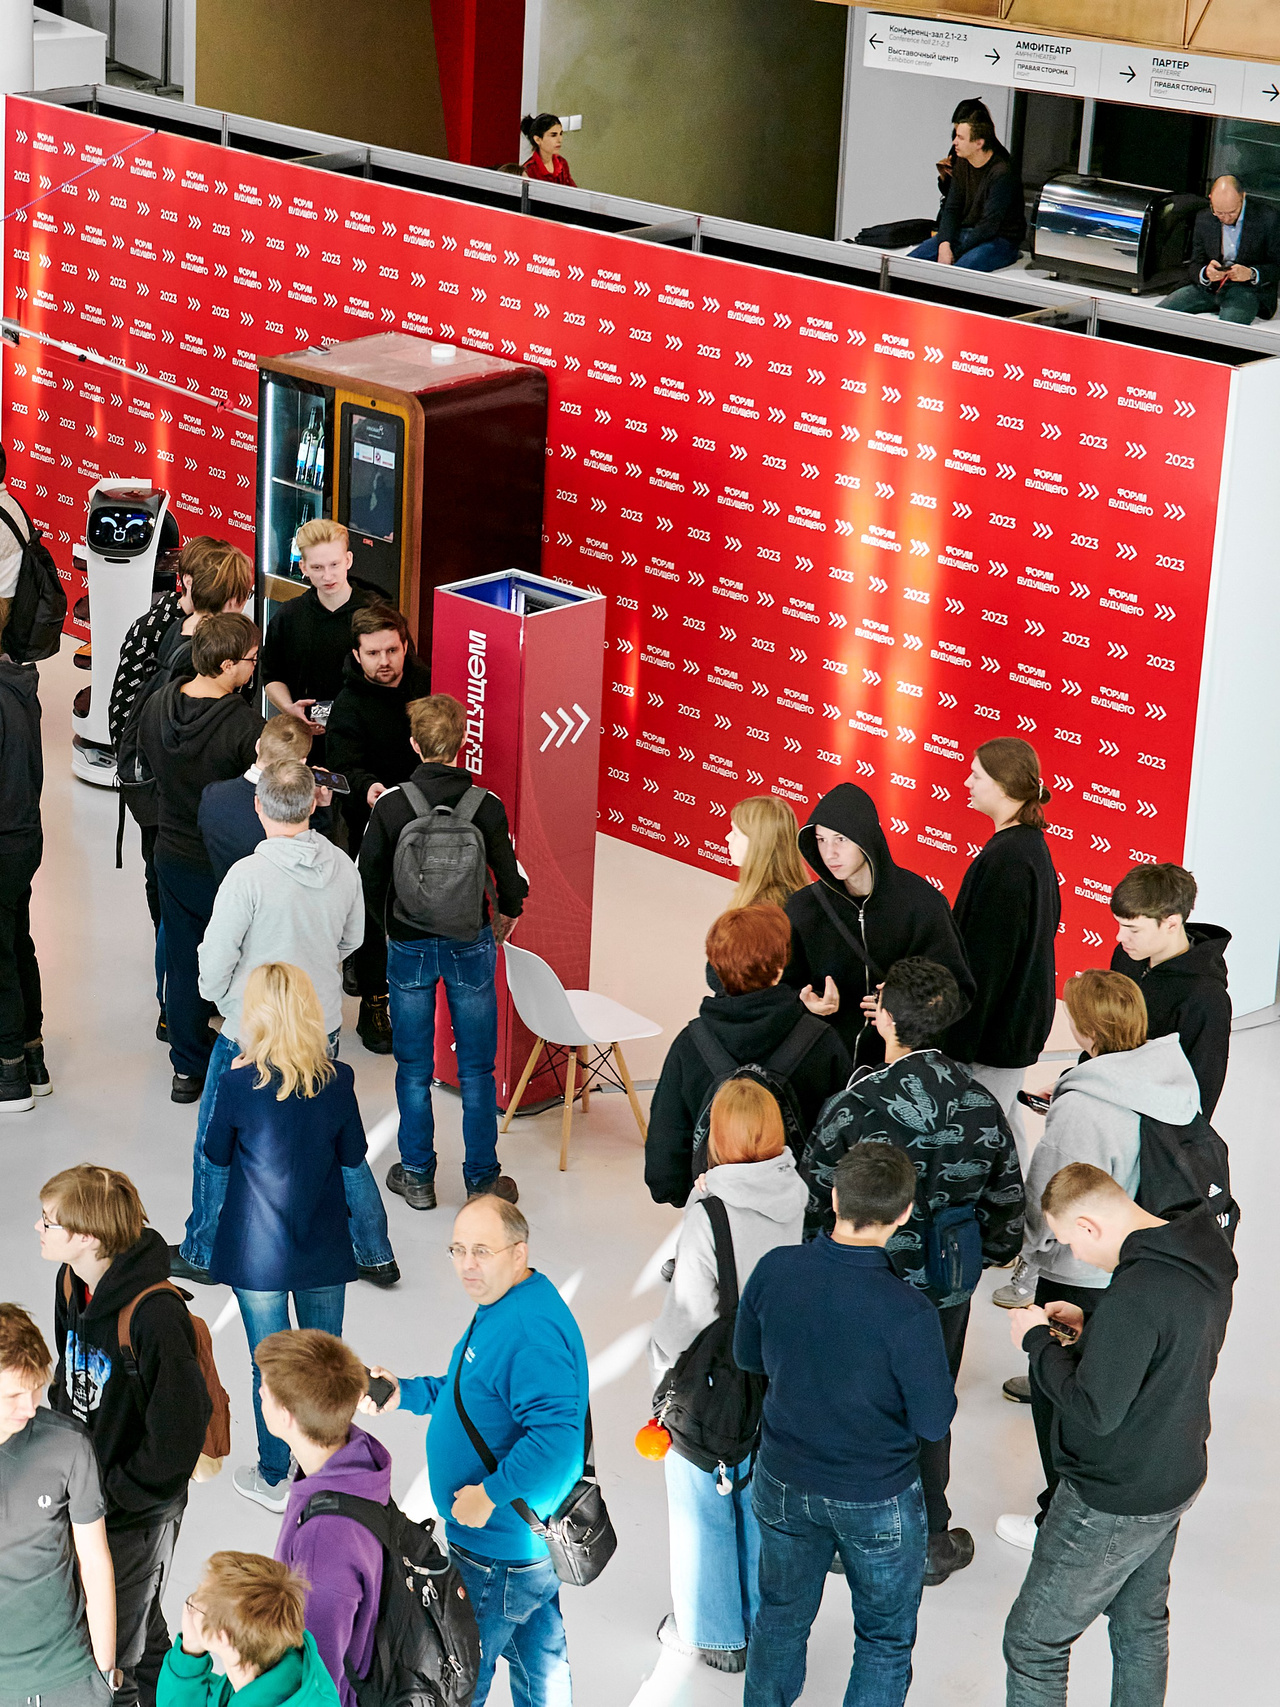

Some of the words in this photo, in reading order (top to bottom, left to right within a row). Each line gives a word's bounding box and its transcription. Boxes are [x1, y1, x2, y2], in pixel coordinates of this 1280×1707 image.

[889, 25, 944, 39] Конференц-зал
[944, 32, 968, 42] 2.1-2.3
[889, 33, 920, 44] Conference
[888, 46, 937, 59] Выставочный
[937, 54, 960, 63] центр
[1016, 41, 1072, 55] АМФИТЕАТР
[888, 55, 915, 64] Exhibition
[915, 59, 933, 67] center
[1152, 57, 1190, 70] ПАРТЕР
[1017, 63, 1041, 72] ПРАВАЯ
[1041, 66, 1069, 75] СТОРОНА
[1151, 67, 1182, 77] PARTERRE
[1154, 80, 1181, 90] ПРАВАЯ
[1181, 84, 1213, 94] СТОРОНА
[14, 170, 30, 183] 2023
[110, 196, 127, 209] 2023
[213, 223, 230, 236] 2023
[266, 237, 284, 250] 2023
[61, 262, 77, 275] 2023
[379, 265, 399, 279] 2023
[598, 269, 621, 282] ФОРУМ
[438, 280, 459, 295] 2023
[160, 290, 177, 303] 2023
[500, 296, 521, 310] 2023
[735, 301, 759, 313] ФОРУМ
[563, 312, 585, 326] 2023
[265, 320, 283, 334] 2023
[629, 328, 651, 342] 2023
[882, 334, 909, 347] ФОРУМ
[697, 344, 720, 359] 2023
[960, 351, 988, 364] ФОРУМ
[768, 361, 792, 376] 2023
[1042, 368, 1070, 382] ФОРУМ
[841, 378, 867, 394] 2023
[1127, 386, 1156, 400] ФОРУМ
[12, 402, 28, 414] 2023
[560, 401, 581, 415] 2023
[917, 396, 944, 412] 2023
[60, 417, 75, 430] 2023
[625, 418, 647, 433] 2023
[997, 415, 1024, 430] 2023
[692, 436, 715, 451] 2023
[875, 430, 902, 444] ФОРУМ
[1079, 433, 1107, 449] 2023
[157, 449, 174, 462] 2023
[762, 455, 786, 470] 2023
[953, 449, 980, 463] ФОРУМ
[1165, 453, 1194, 469] 2023
[209, 466, 226, 479] 2023
[1034, 468, 1062, 482] ФОРУМ
[835, 473, 860, 489] 2023
[58, 493, 73, 506] 2023
[556, 489, 577, 503] 2023
[910, 493, 937, 509] 2023
[1117, 488, 1147, 502] ФОРУМ
[621, 508, 643, 522] 2023
[989, 513, 1016, 529] 2023
[688, 527, 710, 542] 2023
[869, 525, 895, 539] ФОРУМ
[1070, 533, 1099, 549] 2023
[757, 547, 780, 562] 2023
[946, 546, 973, 560] ФОРУМ
[651, 557, 674, 570] ФОРУМ
[1155, 554, 1184, 571] 2023
[829, 567, 854, 583] 2023
[1025, 567, 1054, 581] ФОРУМ
[617, 595, 638, 610] 2023
[903, 588, 930, 604] 2023
[1108, 588, 1138, 603] ФОРУМ
[683, 616, 705, 631] 2023
[981, 609, 1008, 625] 2023
[862, 619, 889, 633] ФОРУМ
[752, 637, 775, 652] 2023
[1062, 632, 1090, 648] 2023
[939, 641, 965, 655] ФОРУМ
[823, 659, 848, 675] 2023
[1146, 654, 1175, 671] 2023
[714, 666, 738, 679] ФОРУМ
[1018, 663, 1045, 678] ФОРУМ
[612, 682, 635, 697] 2023
[896, 681, 923, 697] 2023
[1100, 686, 1129, 701] ФОРУМ
[678, 704, 700, 719] 2023
[856, 711, 882, 725] ФОРУМ
[974, 704, 1000, 720] 2023
[643, 731, 665, 744] ФОРУМ
[746, 726, 769, 742] 2023
[932, 734, 958, 749] ФОРУМ
[1054, 728, 1081, 744] 2023
[817, 749, 842, 765] 2023
[1137, 753, 1166, 770] 2023
[608, 767, 629, 782] 2023
[890, 773, 916, 789] 2023
[673, 790, 695, 805] 2023
[1091, 783, 1120, 798] ФОРУМ
[925, 826, 951, 841] ФОРУМ
[1046, 823, 1073, 840] 2023
[1129, 849, 1157, 864] 2023
